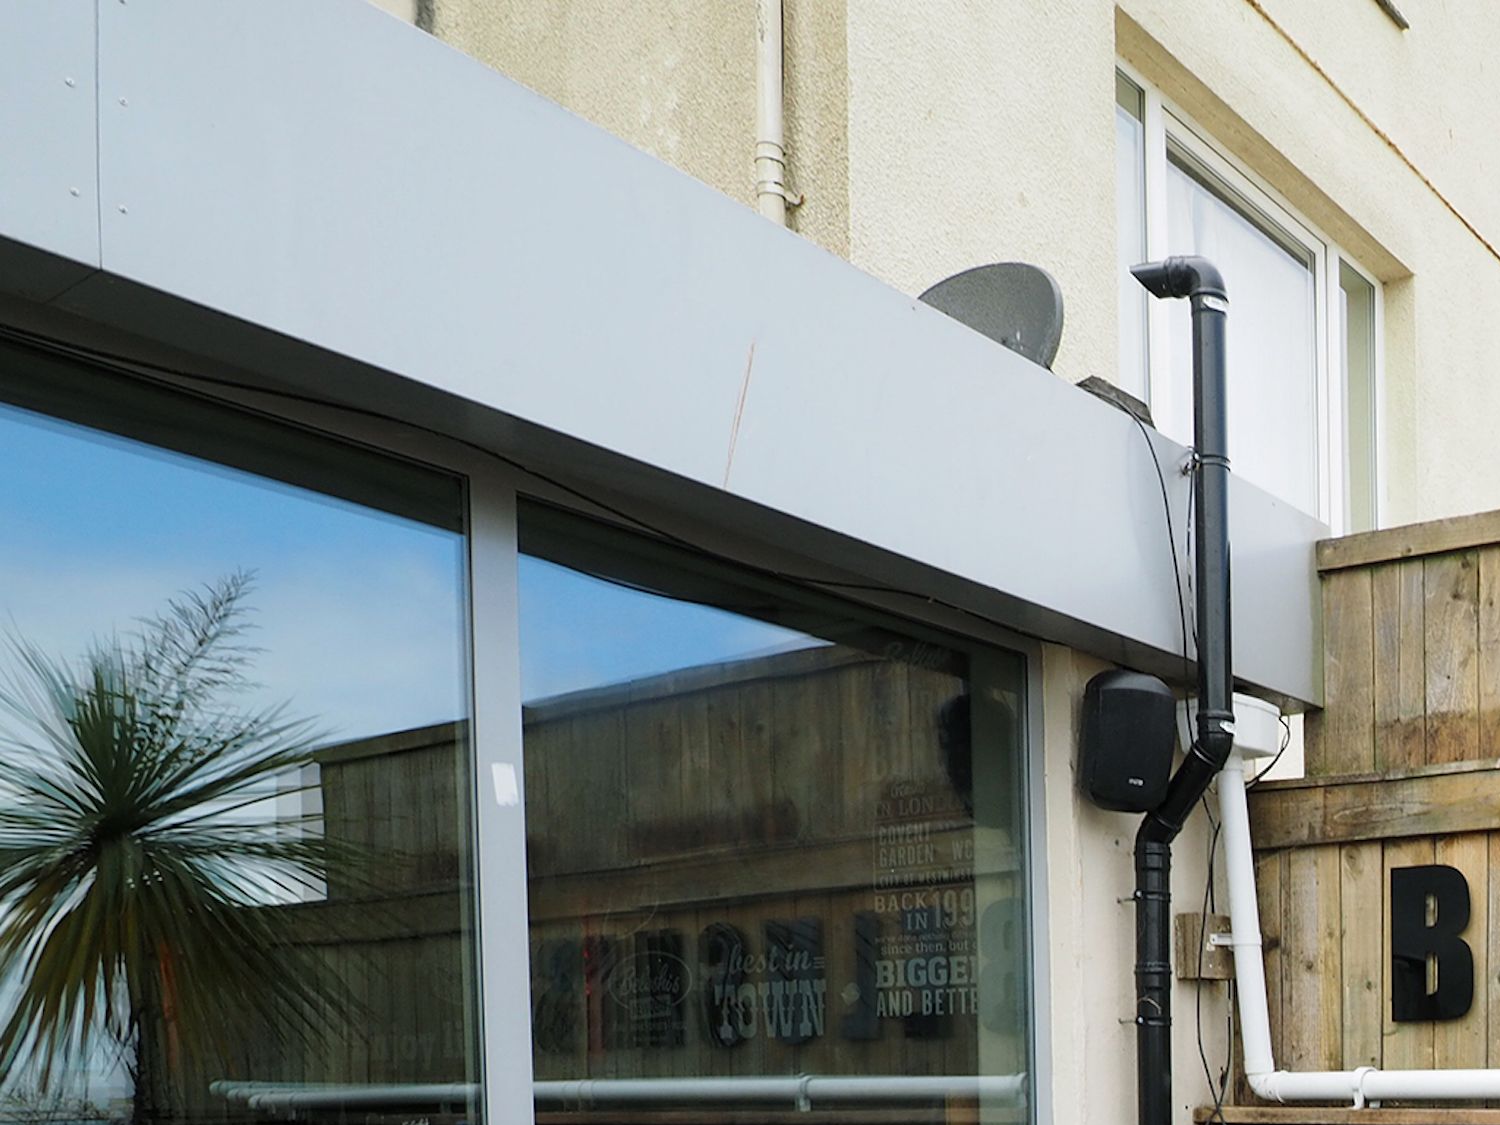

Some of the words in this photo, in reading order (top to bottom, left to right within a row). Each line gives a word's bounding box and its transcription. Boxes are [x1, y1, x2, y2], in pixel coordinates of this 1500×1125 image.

[879, 822, 931, 846] COVENT
[879, 844, 934, 867] GARDEN
[874, 892, 928, 912] BACK
[907, 913, 928, 930] IN
[728, 945, 784, 975] best
[785, 943, 814, 971] in
[881, 942, 912, 956] since
[714, 979, 826, 1039] TOWN
[876, 990, 913, 1017] AND
